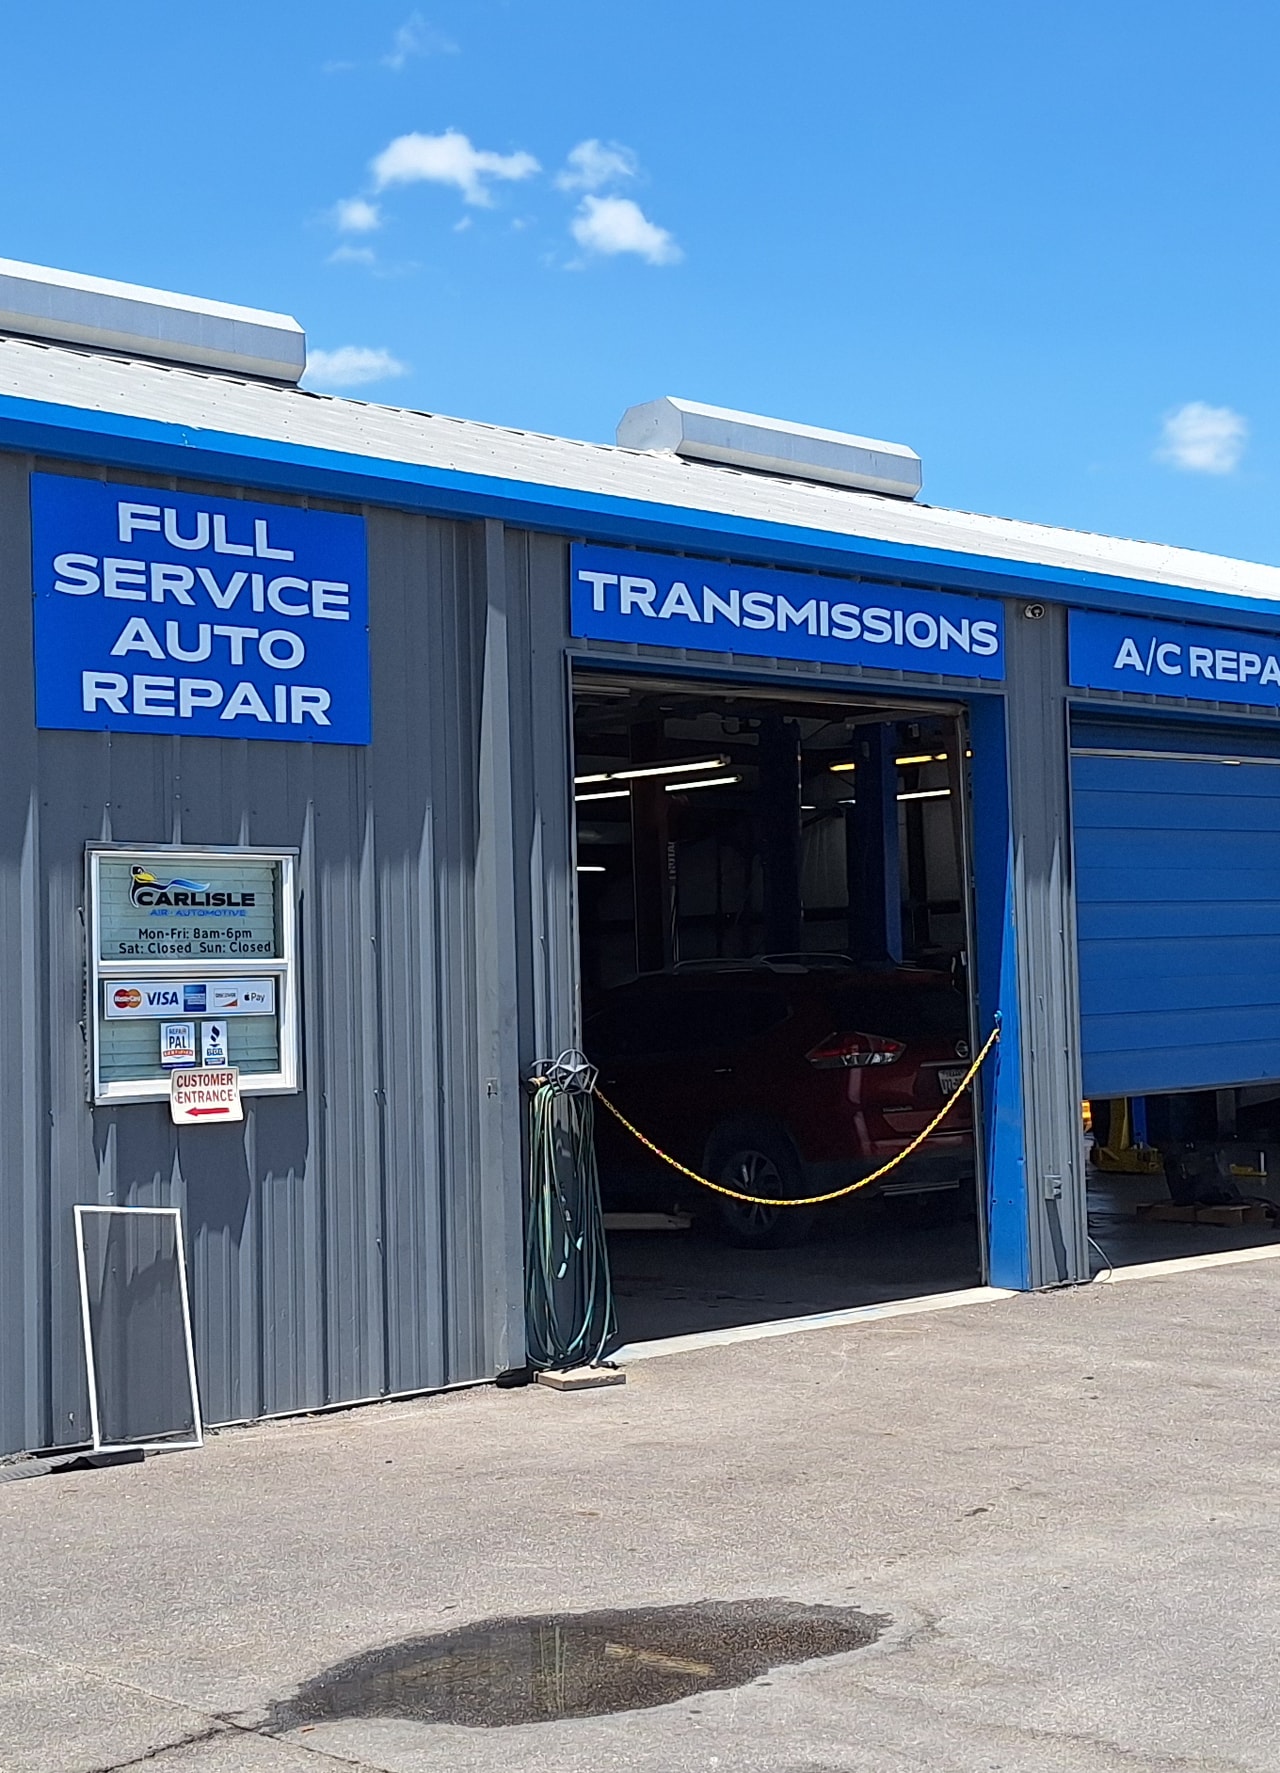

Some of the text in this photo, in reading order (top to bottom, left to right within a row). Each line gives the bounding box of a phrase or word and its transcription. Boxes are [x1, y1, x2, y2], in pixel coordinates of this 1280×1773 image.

[118, 501, 295, 562] FULL
[53, 553, 351, 621] SERVICE
[577, 570, 1000, 656] TRANSMISSIONS
[109, 616, 306, 670] AUTO
[1113, 636, 1182, 676] A/C
[81, 670, 332, 727] REPAIR
[137, 891, 256, 907] CARLISLE
[149, 908, 248, 917] AIR AUTOMOTIVE
[138, 927, 252, 942] Mon-Fri: 8am-6pm
[119, 940, 271, 954] Sat: Closed Sun: Closed
[145, 991, 180, 1006] VISA
[250, 992, 266, 1004] Pay
[168, 1035, 187, 1049] PAL
[176, 1072, 234, 1088] CUSTOMER
[177, 1089, 234, 1104] ENTRANCE
